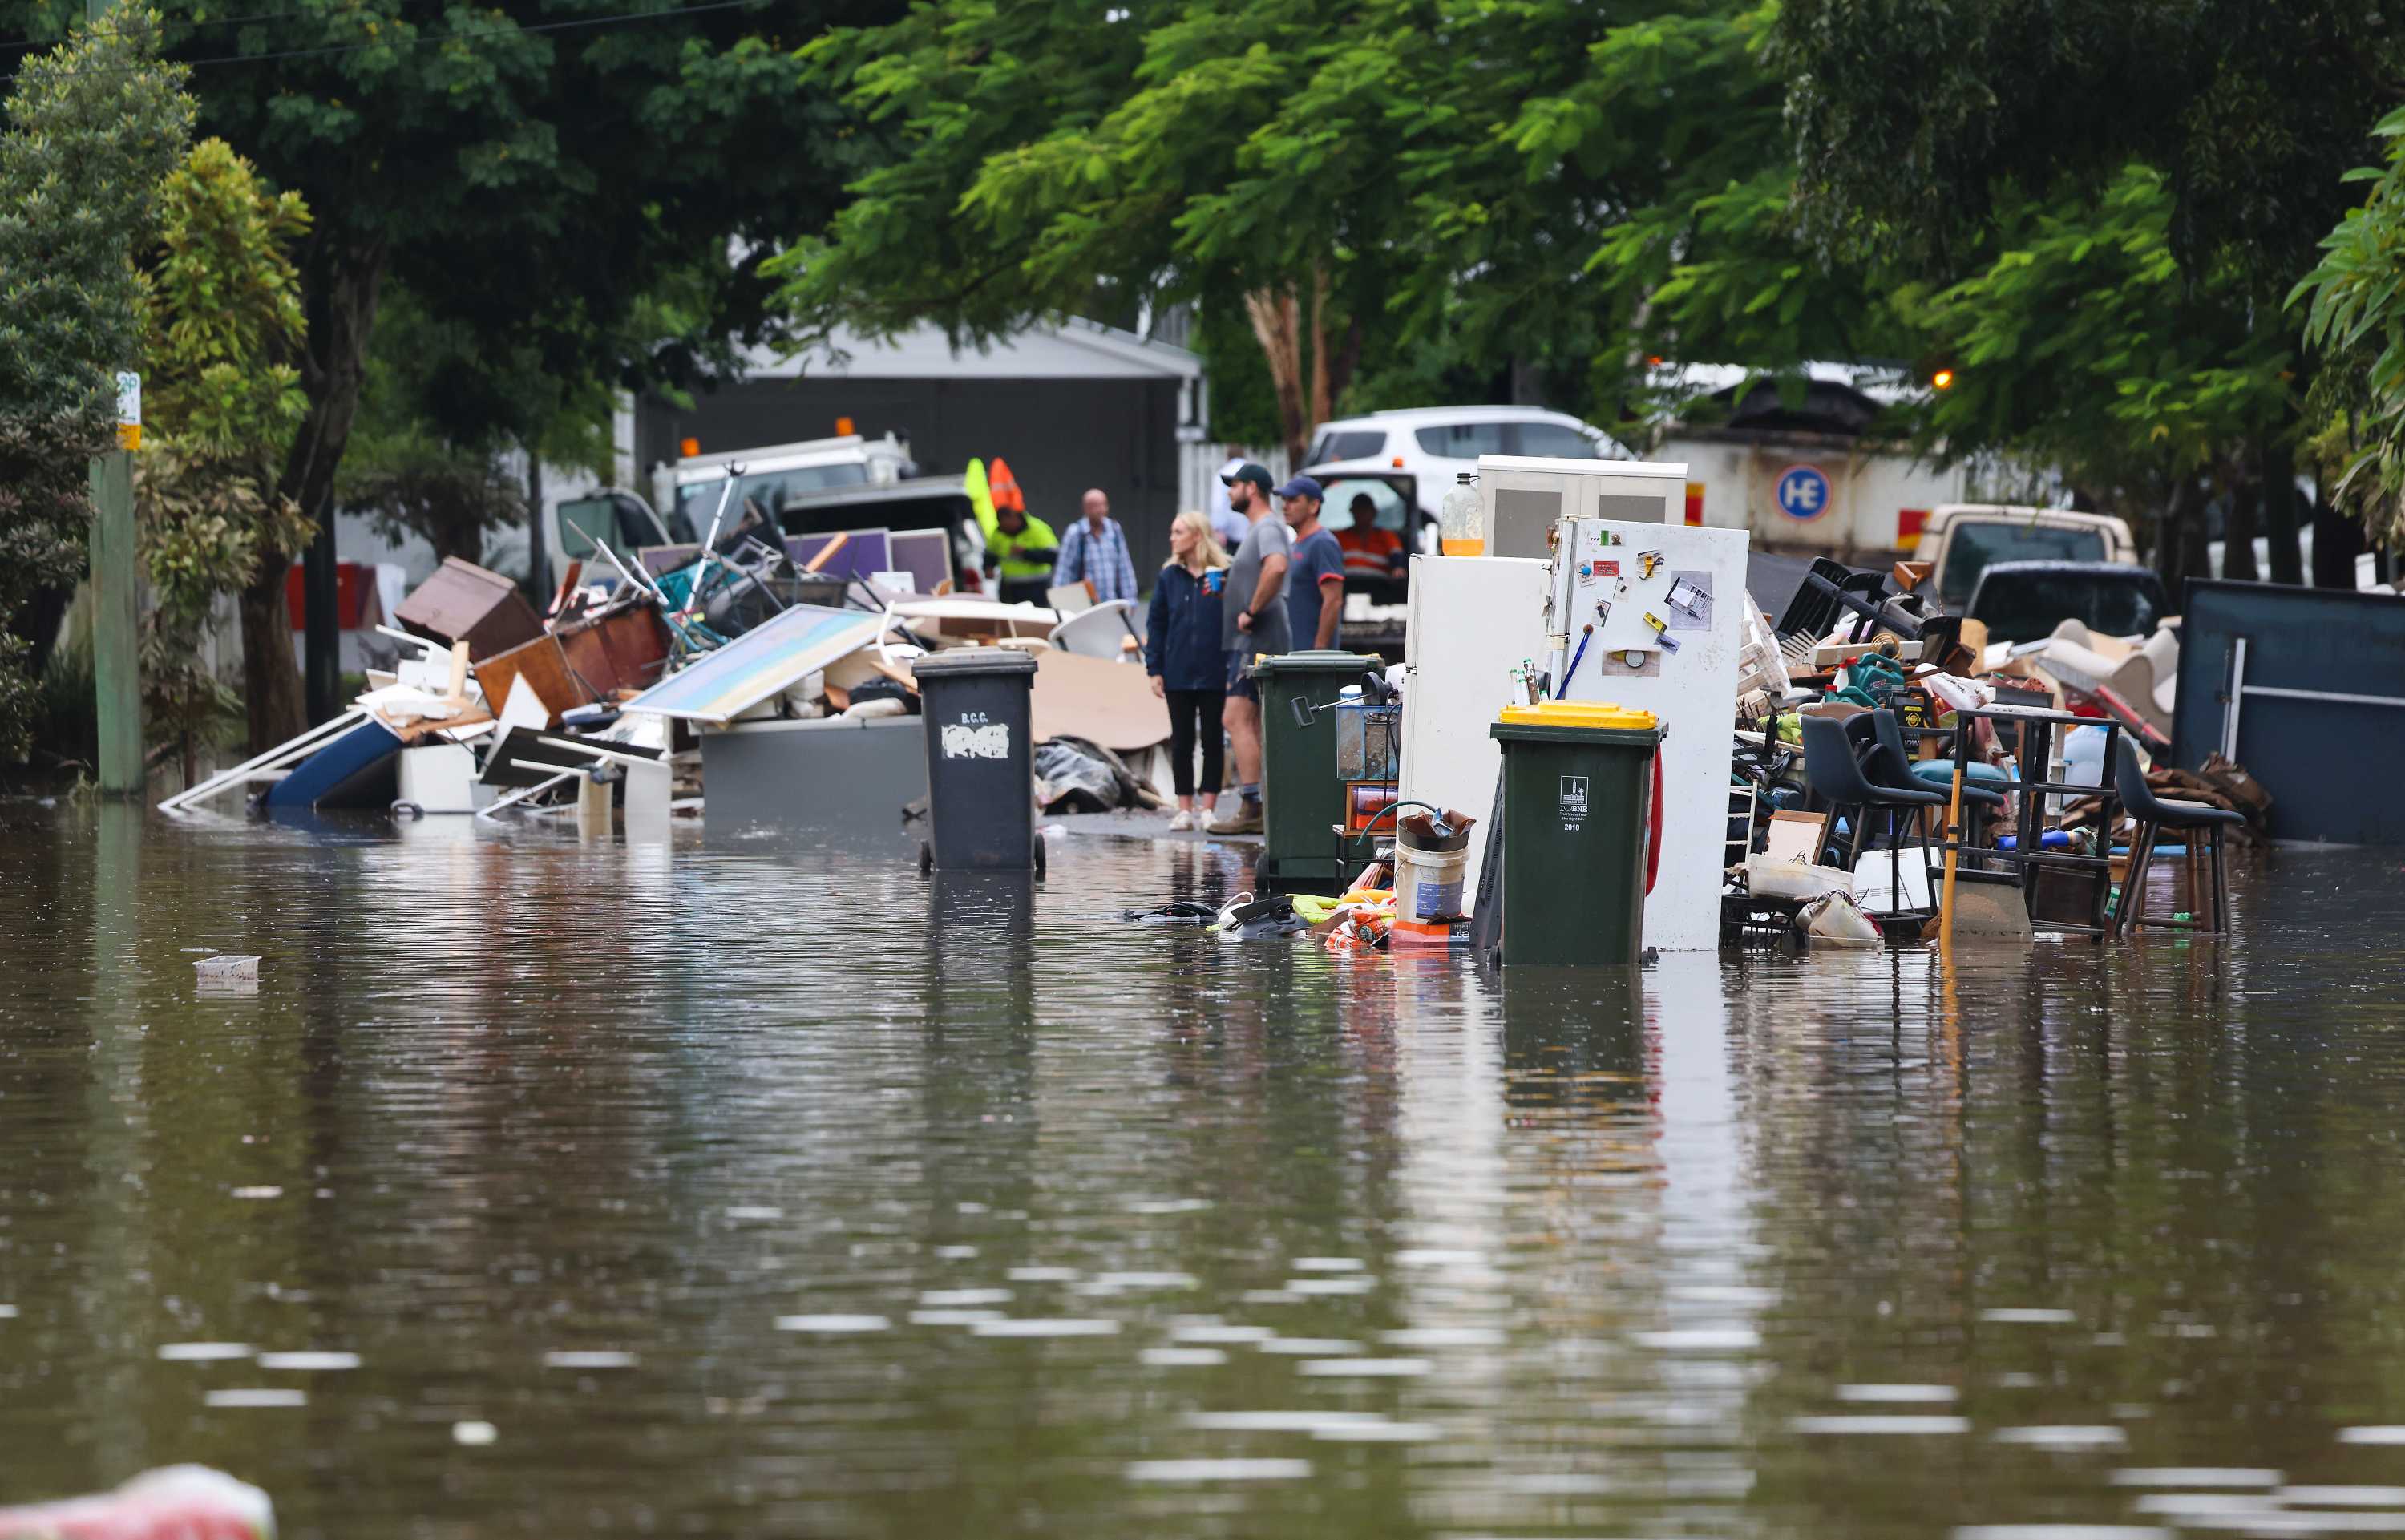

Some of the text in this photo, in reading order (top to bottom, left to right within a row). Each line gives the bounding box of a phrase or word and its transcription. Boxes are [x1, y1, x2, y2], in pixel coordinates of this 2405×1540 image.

[1784, 476, 1820, 510] HE
[961, 711, 988, 724] B.C.C.
[1564, 823, 1580, 831] 2010
